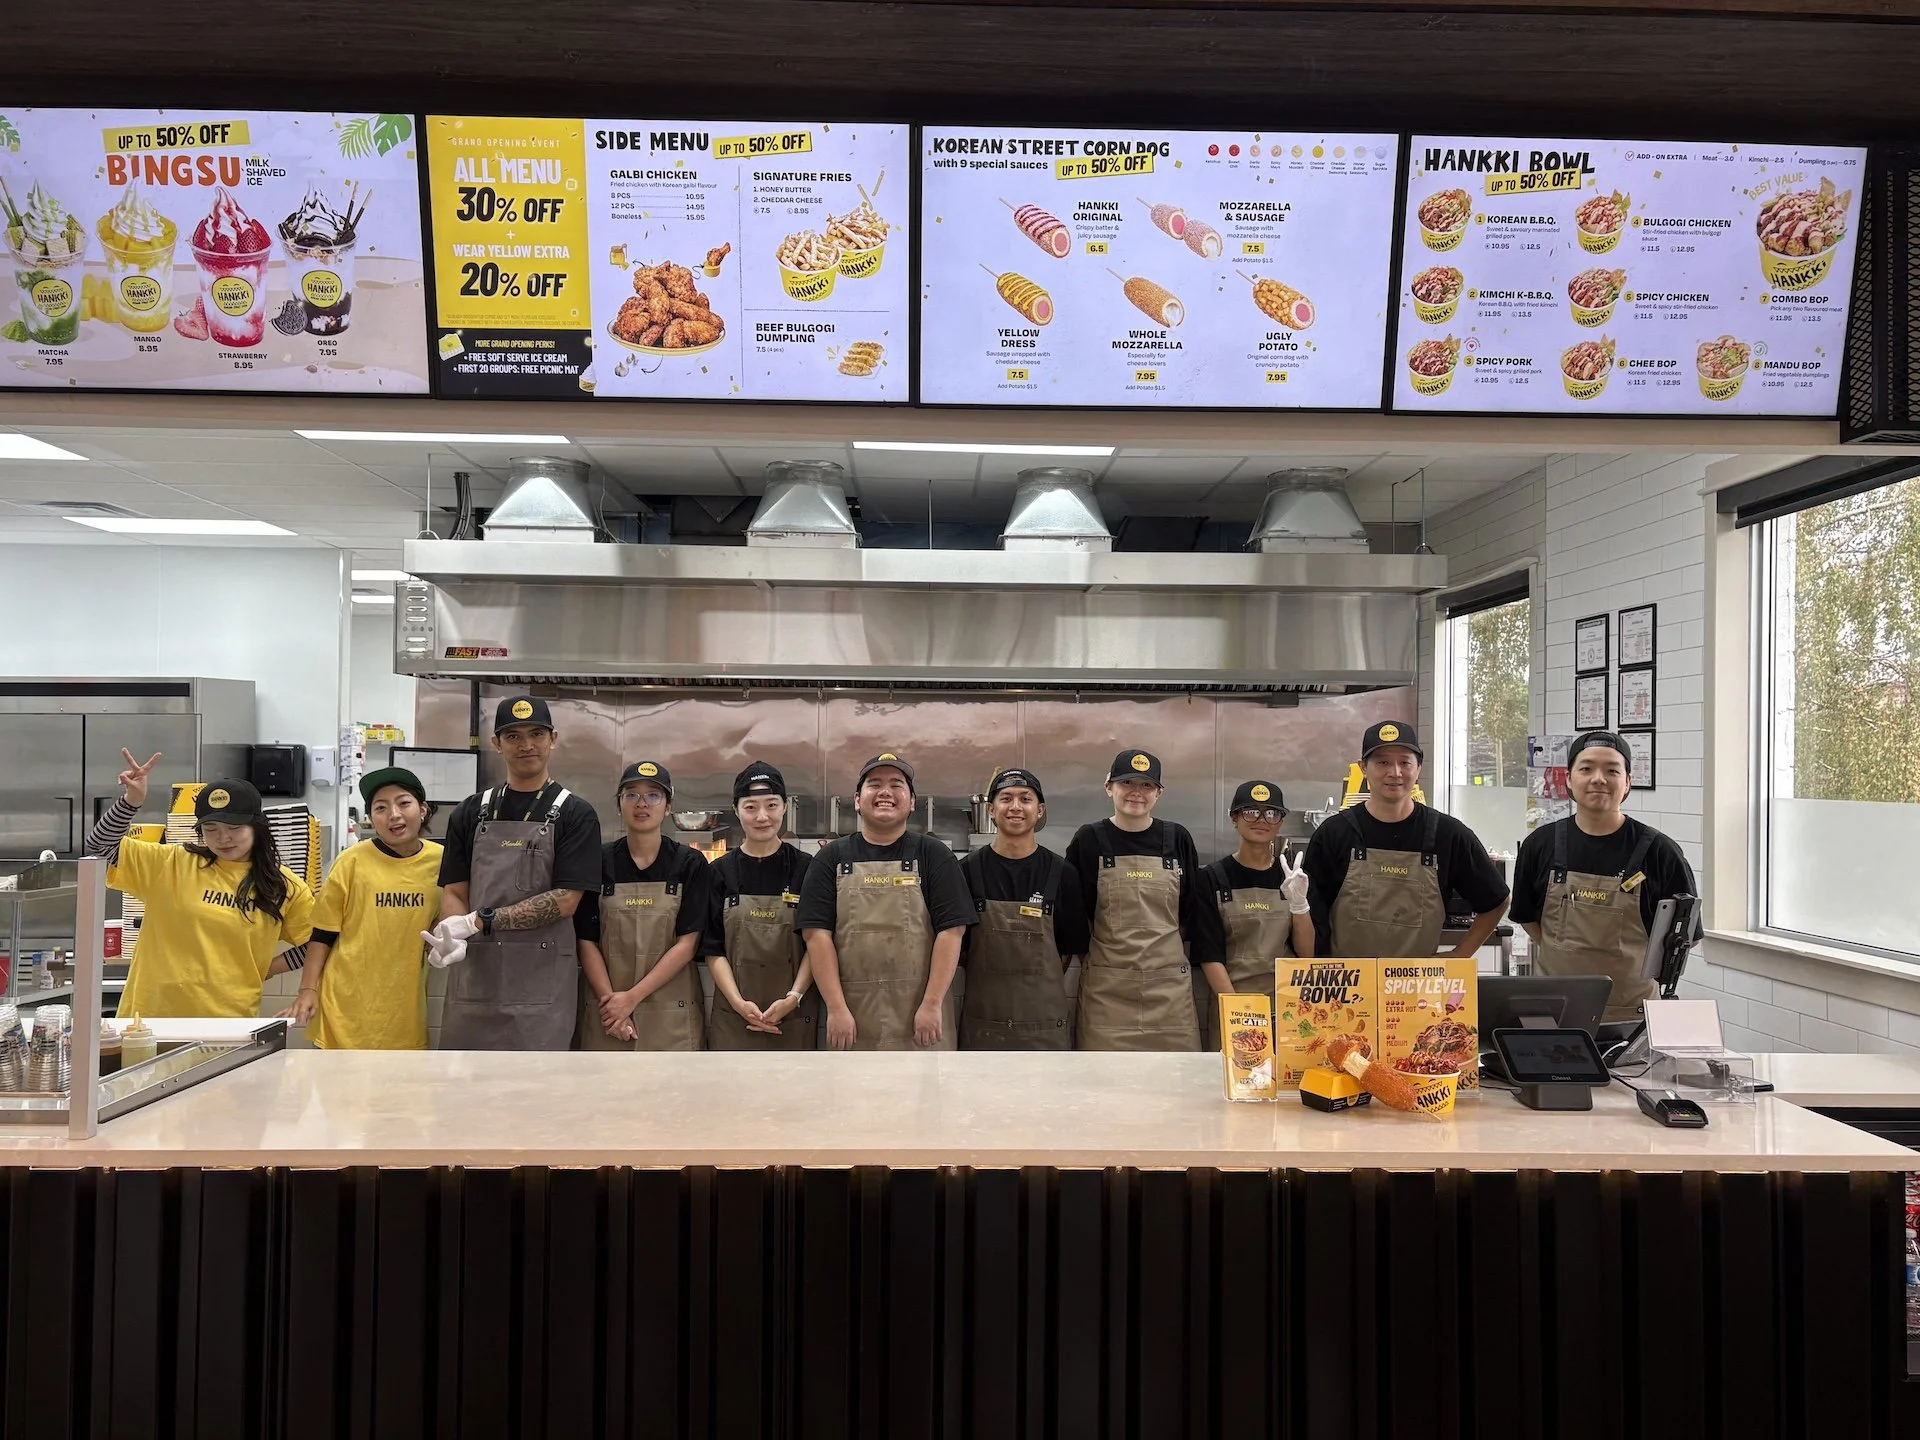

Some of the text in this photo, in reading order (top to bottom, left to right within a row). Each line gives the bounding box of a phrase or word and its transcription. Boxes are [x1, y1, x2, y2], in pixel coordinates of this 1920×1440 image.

[118, 124, 231, 149] UP TO 50% OFF
[595, 131, 709, 151] SIDE MENU
[452, 138, 560, 148] GRAND OPENING EVENT
[720, 134, 806, 155] UP TO 50% OFF
[933, 138, 1169, 157] KOREAN STREET CORN DOG
[246, 159, 269, 167] MILK
[934, 159, 1048, 170] with 9 special sauces
[1062, 156, 1148, 176] UP TO 50% OFF
[1425, 149, 1595, 174] HANKKI BOWL
[107, 155, 241, 186] BINGSU
[246, 169, 286, 177] SHAVED
[454, 158, 561, 184] ALL MENU
[610, 170, 697, 180] GALBI CHICKEN
[247, 178, 262, 186] ICE
[754, 172, 852, 182] SIGNATURE FRIES
[1491, 171, 1576, 191] UP TO 50% OFF
[1748, 172, 1803, 200] BEST VALUE
[457, 187, 564, 223] 30% OFF
[1078, 202, 1118, 211] HANKKI
[1219, 202, 1291, 211] MOZZARELLA
[1073, 212, 1123, 222] ORIGINAL
[1235, 213, 1285, 222] SAUSAGE
[1487, 216, 1527, 224] KOREAN
[1643, 219, 1731, 228] BULGOGI CHICKEN
[453, 244, 570, 259] WEAR YELLOW EXTRA
[1247, 245, 1259, 253] 7.5
[460, 262, 567, 297] 20% OFF
[1479, 291, 1515, 299] KIMCHI
[1636, 293, 1709, 302] SPICY CHICKEN
[1772, 295, 1829, 304] COMBO BOP
[756, 323, 835, 332] BEEF BULGOGI
[998, 329, 1040, 337] YELLOW
[1266, 332, 1292, 341] UGLY
[756, 334, 815, 343] DUMPLING
[492, 340, 509, 348] GRAND
[1112, 341, 1182, 349] MOZZARELLA
[1259, 343, 1298, 351] POTATO
[469, 353, 567, 362] FREE SOFT SERVE ICE CREAM
[1506, 358, 1532, 366] PORK
[458, 364, 579, 374] FIRST 20 GROUPS: FREE PICNIC MAT
[1629, 360, 1677, 368] CHEE BOP
[1764, 361, 1821, 370] MANDU BOP
[375, 891, 424, 908] HANKKi
[1385, 967, 1444, 977] CHOOSE YOUR
[1291, 969, 1360, 986] HANKKi
[1384, 979, 1466, 994] SPICY LEVEL
[1412, 1086, 1451, 1111] ANKKi
